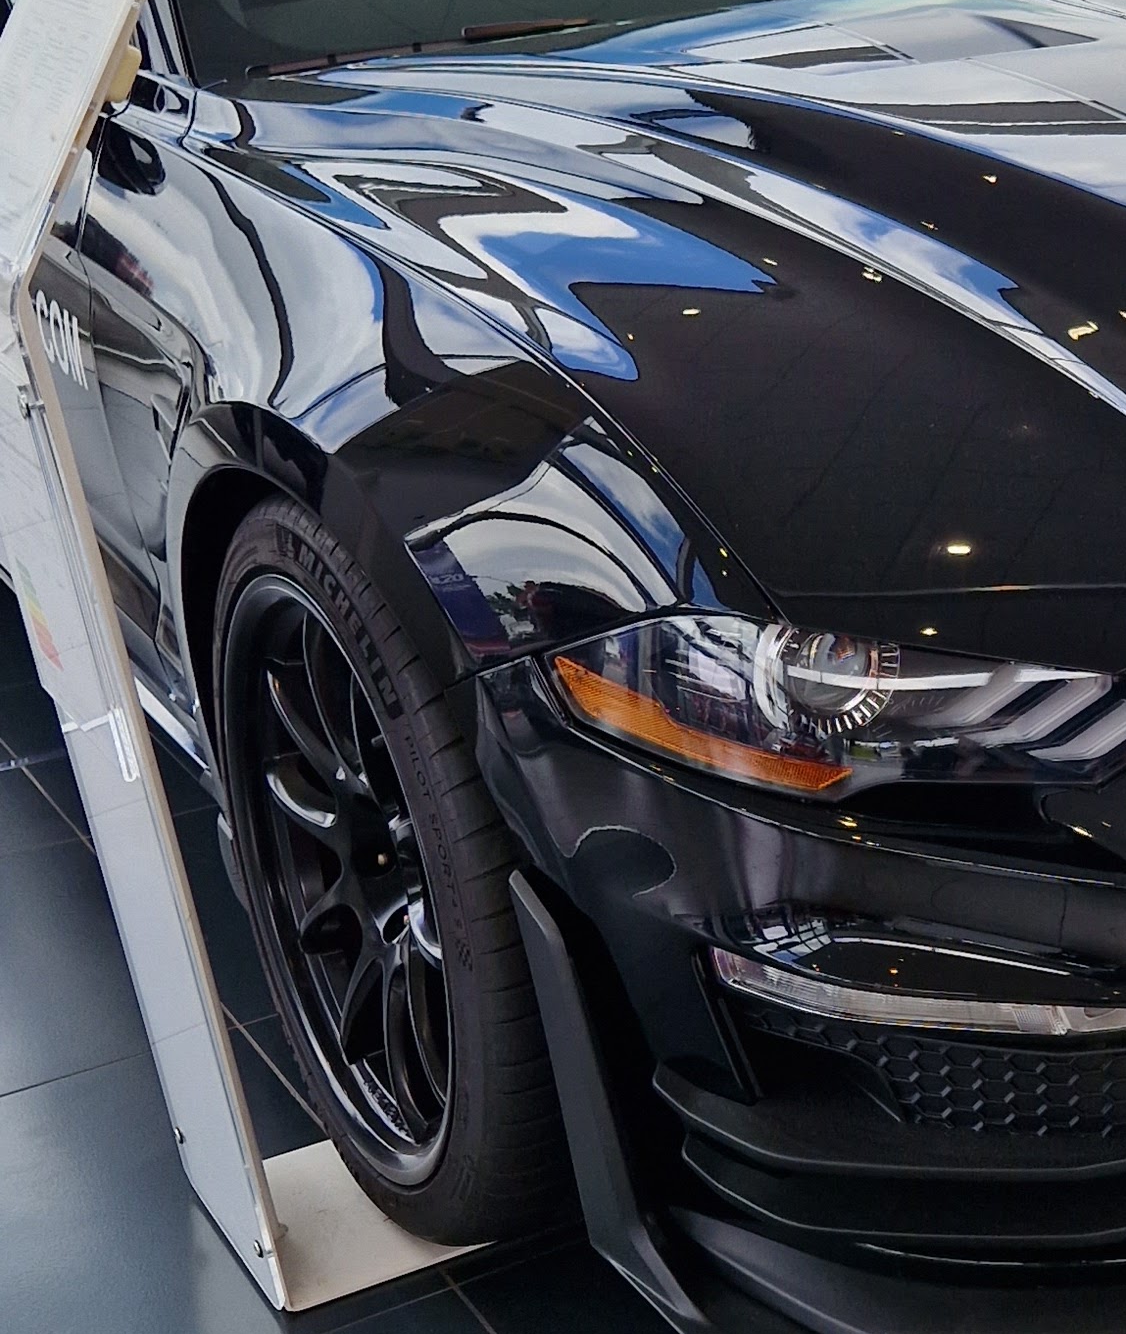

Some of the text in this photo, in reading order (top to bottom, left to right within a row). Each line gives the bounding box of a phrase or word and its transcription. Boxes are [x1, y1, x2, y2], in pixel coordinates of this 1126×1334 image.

[36, 289, 89, 391] COM
[299, 542, 398, 706] MICHELIN
[404, 734, 432, 800] PILOT
[429, 813, 457, 895] SPORT
